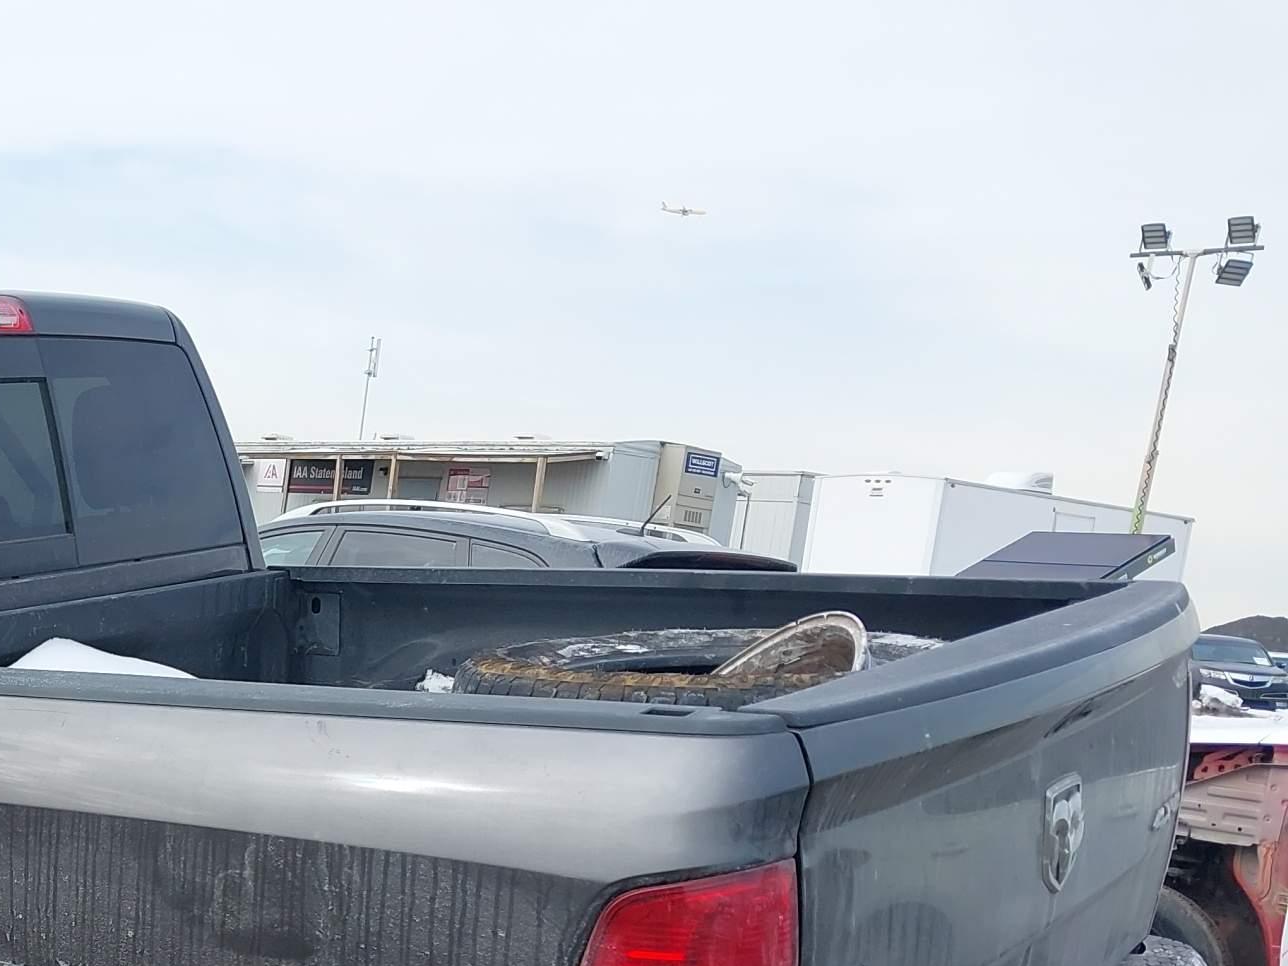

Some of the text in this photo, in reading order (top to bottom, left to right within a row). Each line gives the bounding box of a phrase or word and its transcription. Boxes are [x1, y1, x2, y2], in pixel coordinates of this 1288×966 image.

[293, 465, 363, 480] IAA Staten land
